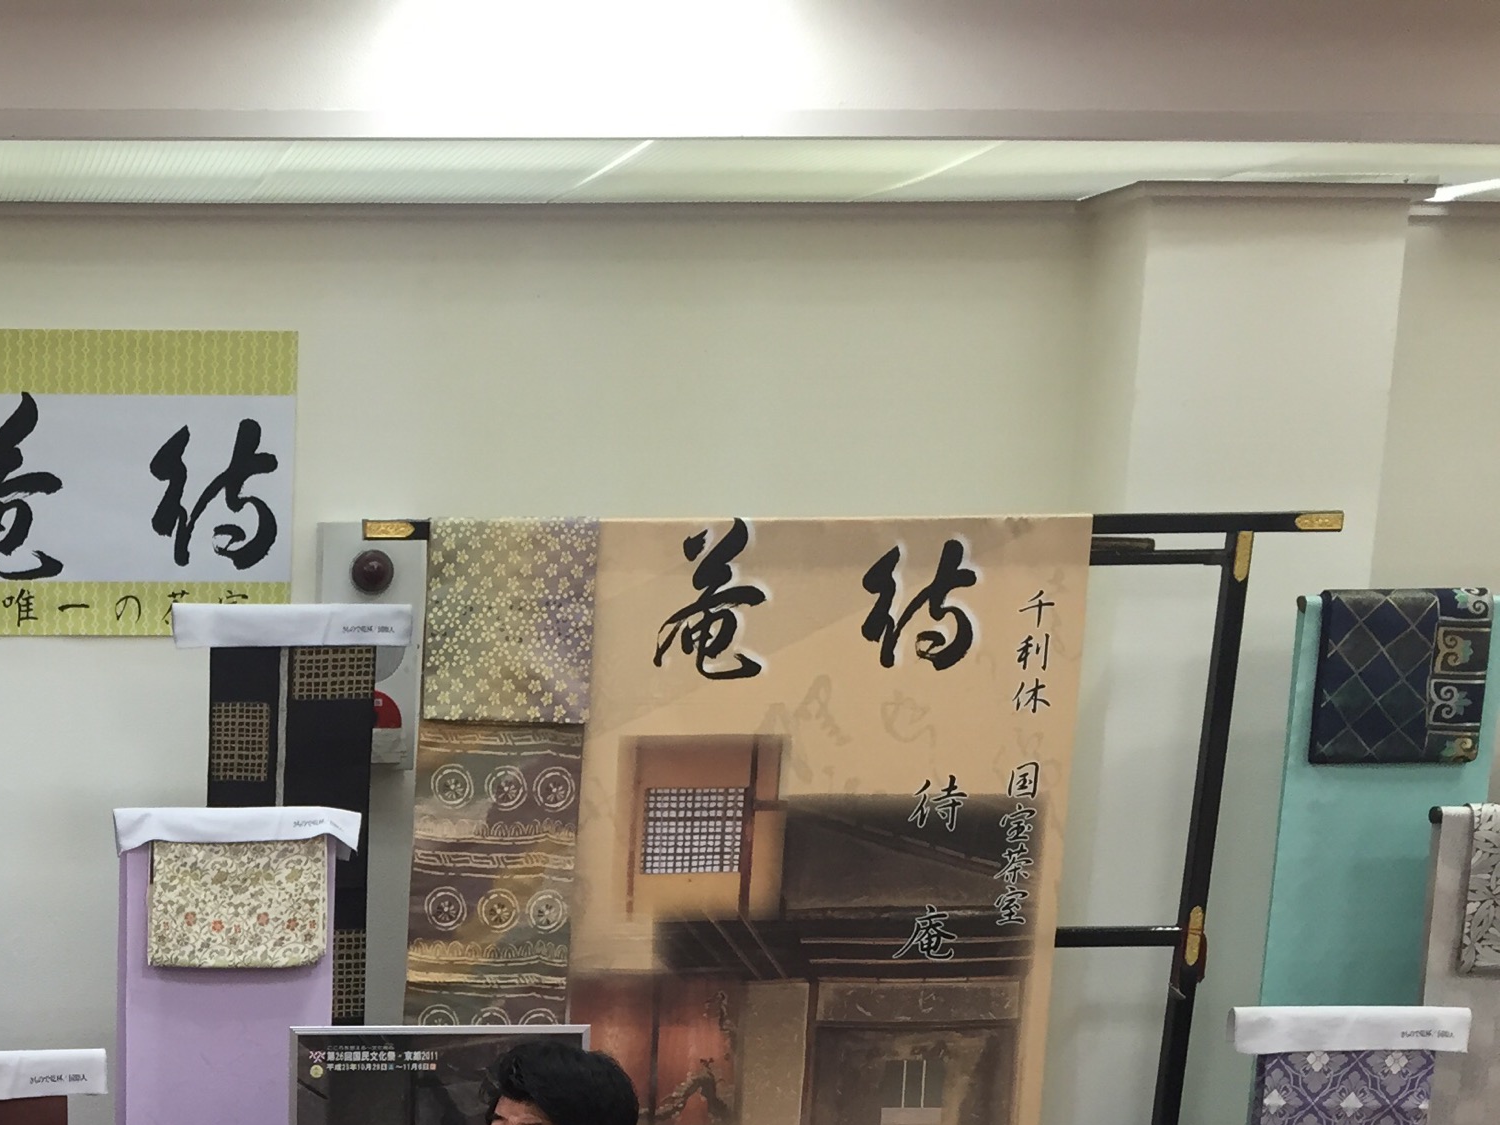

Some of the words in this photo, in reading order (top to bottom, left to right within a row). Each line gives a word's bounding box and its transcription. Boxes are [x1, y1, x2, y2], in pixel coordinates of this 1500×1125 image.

[1011, 589, 1055, 714] 千利休
[993, 761, 1040, 926] 国宝茶室
